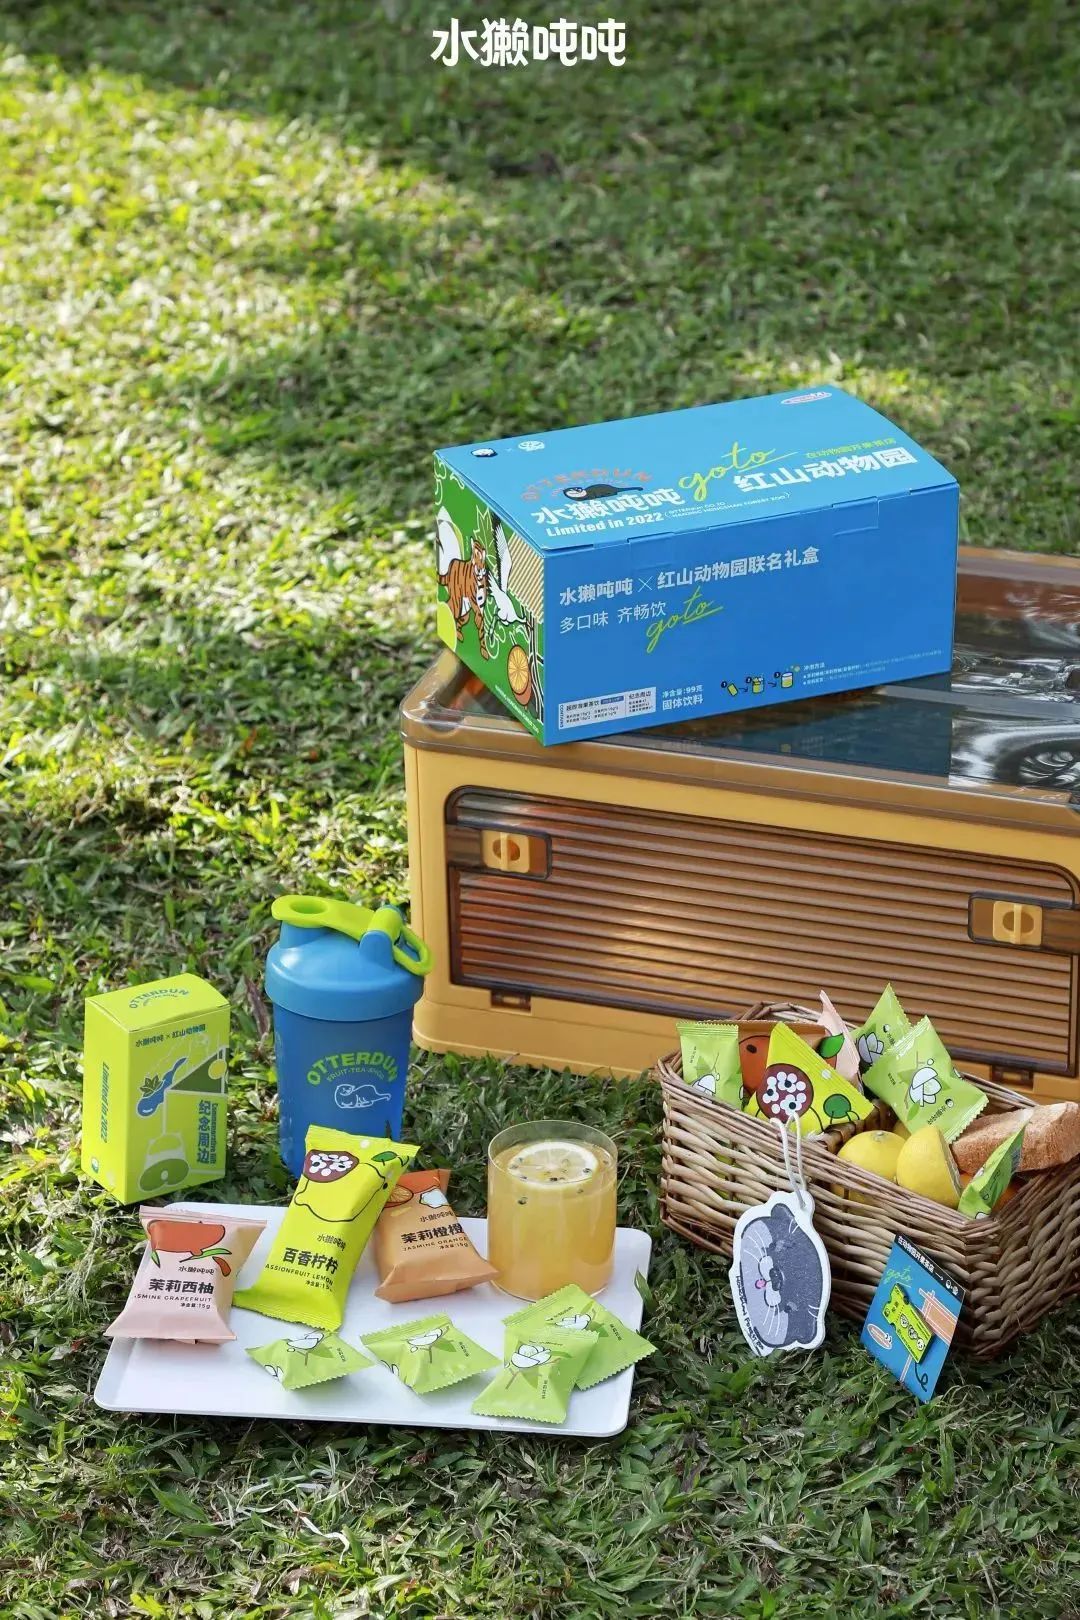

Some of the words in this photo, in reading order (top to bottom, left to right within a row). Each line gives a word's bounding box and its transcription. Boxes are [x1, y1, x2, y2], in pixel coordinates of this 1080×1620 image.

[733, 446, 918, 492] 红山动物园
[531, 488, 686, 525] 水獭吨吨
[546, 520, 606, 537] Limited
[609, 518, 624, 529] in
[626, 512, 664, 526] 2022
[559, 577, 634, 607] 水獭吨吨
[657, 546, 820, 590] 红山动物园联名礼盒
[559, 610, 609, 634] 多口味
[617, 600, 667, 625] 齐畅饮
[662, 693, 704, 711] 固体饮料
[307, 1051, 398, 1086] OTTERDUN
[401, 1222, 463, 1243] 茉莉橙橙
[402, 1241, 436, 1252] JASMINE
[437, 1236, 469, 1245] ORANGE
[283, 1247, 339, 1274] 百香柠柠
[148, 1278, 214, 1295] 茉莉西柚
[265, 1263, 311, 1278] ASSIONFRUIT
[312, 1274, 334, 1286] LEMON
